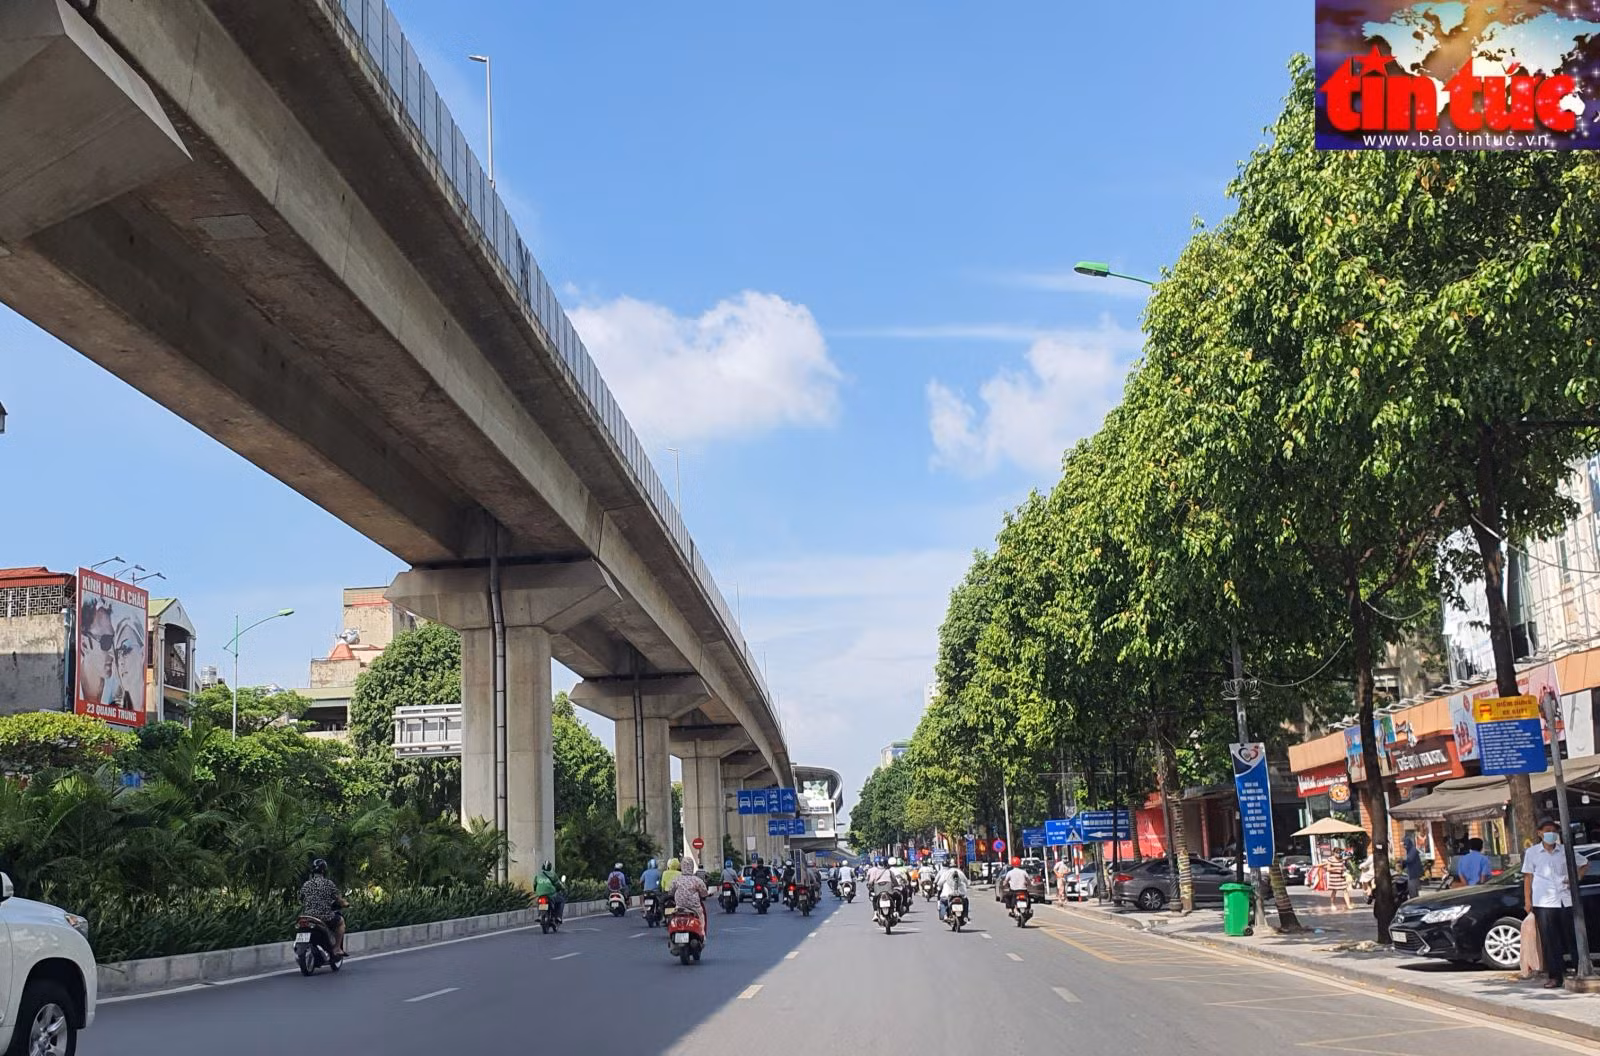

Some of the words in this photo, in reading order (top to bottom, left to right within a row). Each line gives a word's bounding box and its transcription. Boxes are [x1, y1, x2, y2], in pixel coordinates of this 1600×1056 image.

[82, 575, 102, 594] KÍNH
[86, 703, 95, 714] 23
[95, 705, 117, 718] QUANG
[117, 709, 137, 722] TRUNG
